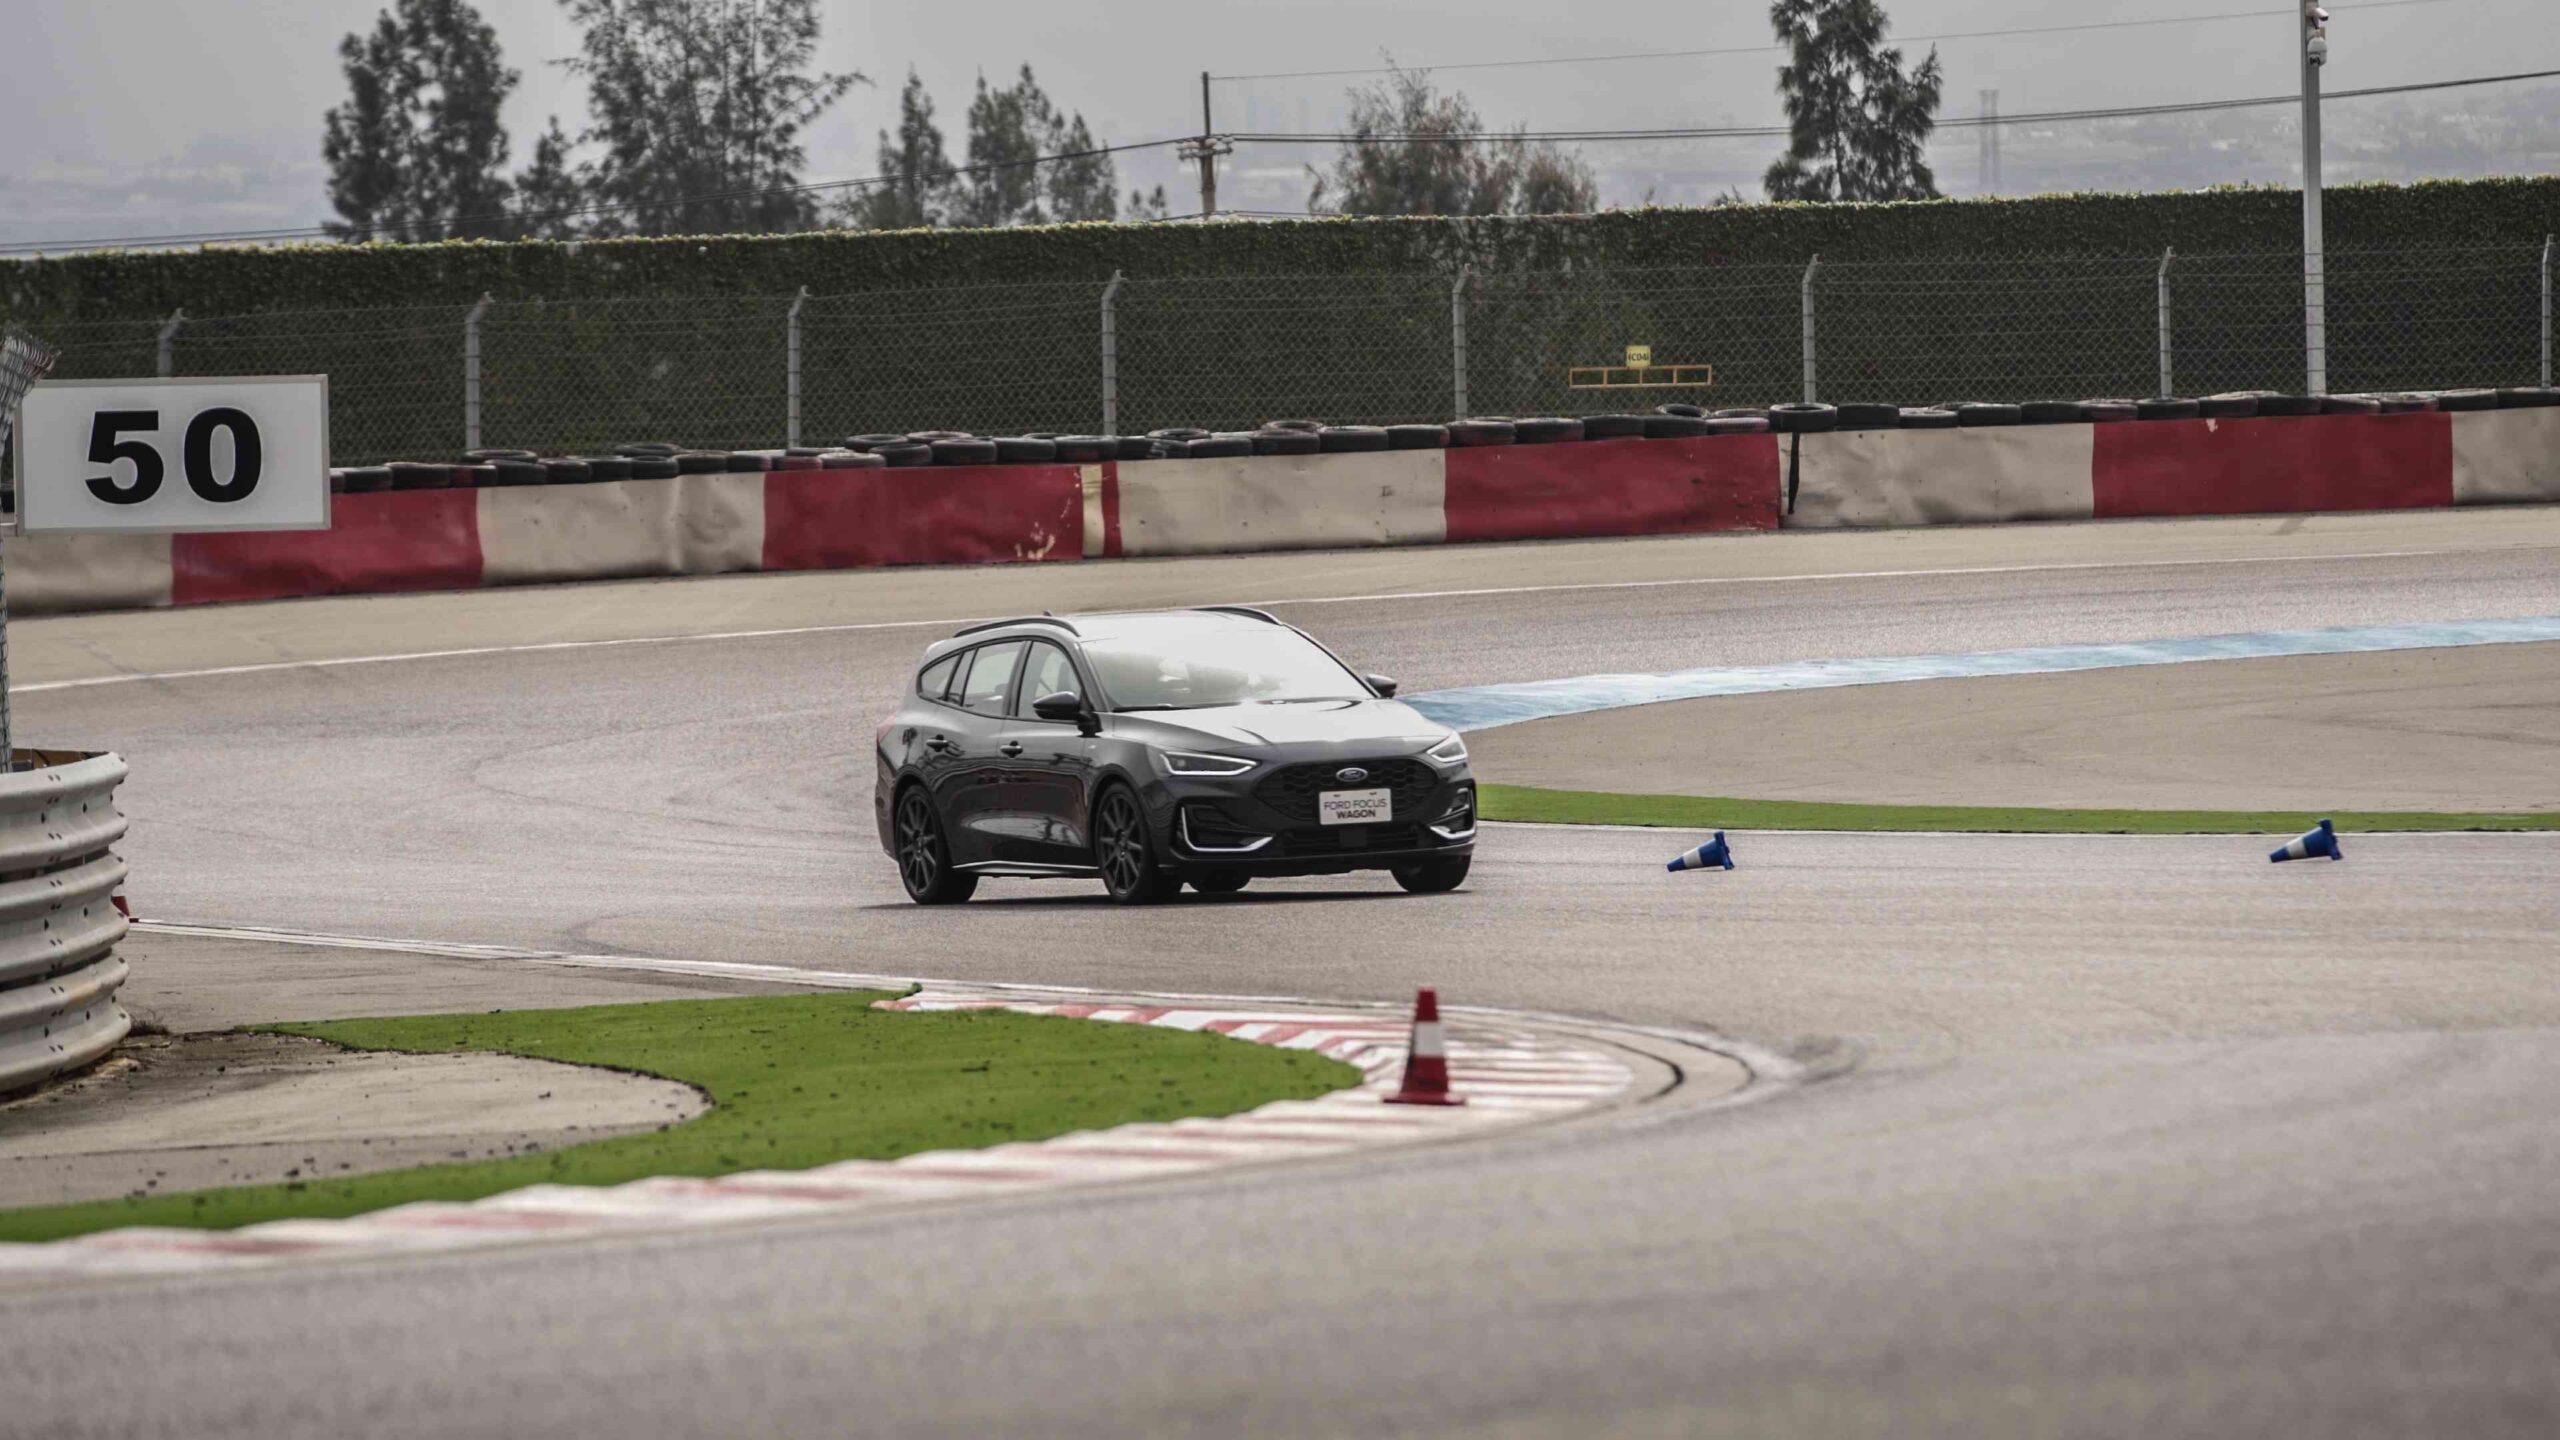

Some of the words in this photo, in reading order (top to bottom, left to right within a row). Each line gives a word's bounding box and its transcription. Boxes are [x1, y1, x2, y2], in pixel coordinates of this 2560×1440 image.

[85, 407, 262, 504] 50
[1324, 800, 1351, 810] FORD
[1353, 798, 1388, 808] FOCUS
[1336, 809, 1376, 819] WAGON
